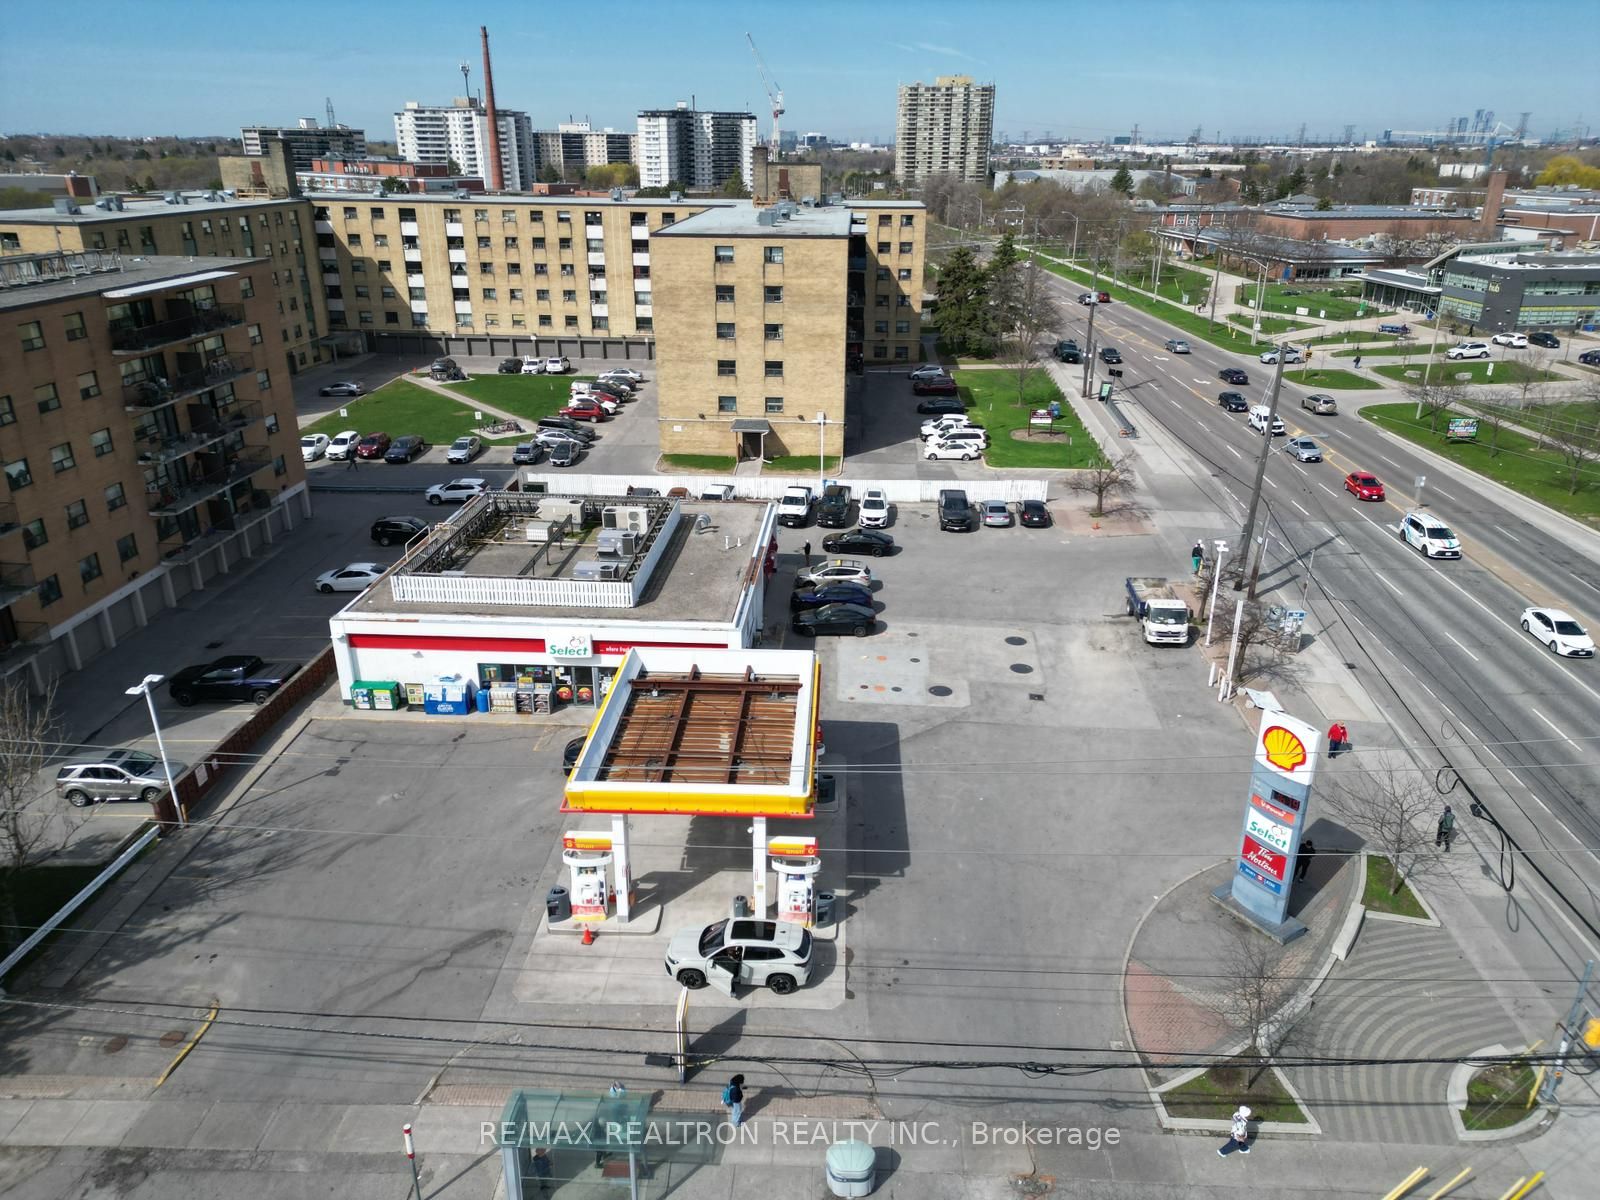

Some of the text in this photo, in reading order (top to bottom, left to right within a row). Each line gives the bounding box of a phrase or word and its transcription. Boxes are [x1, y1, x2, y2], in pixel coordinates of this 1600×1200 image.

[550, 644, 588, 656] Select
[1249, 821, 1287, 848] Select
[1247, 851, 1278, 875] Hortons
[1257, 846, 1273, 862] Tim
